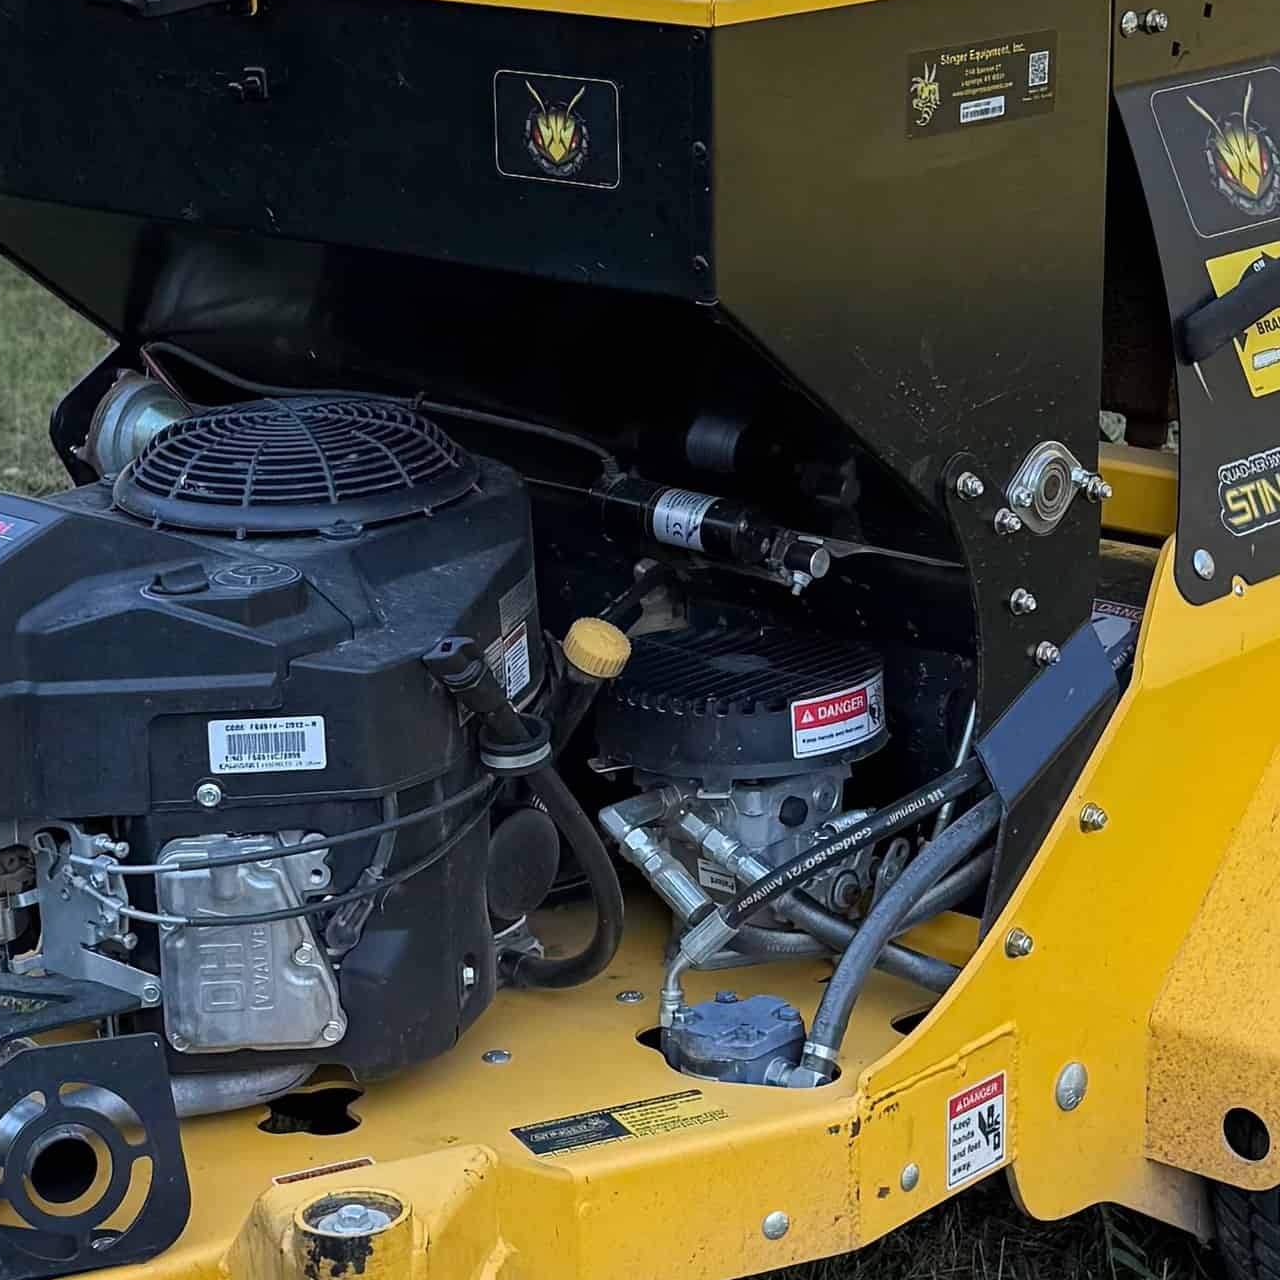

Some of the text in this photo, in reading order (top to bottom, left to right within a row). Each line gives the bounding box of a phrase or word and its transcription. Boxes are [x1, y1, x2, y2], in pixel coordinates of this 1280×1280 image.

[940, 52, 968, 65] Stinger
[817, 696, 864, 720] DANGER
[963, 1082, 998, 1108] DANGER
[953, 1118, 972, 1130] Keep
[953, 1147, 966, 1161] and
